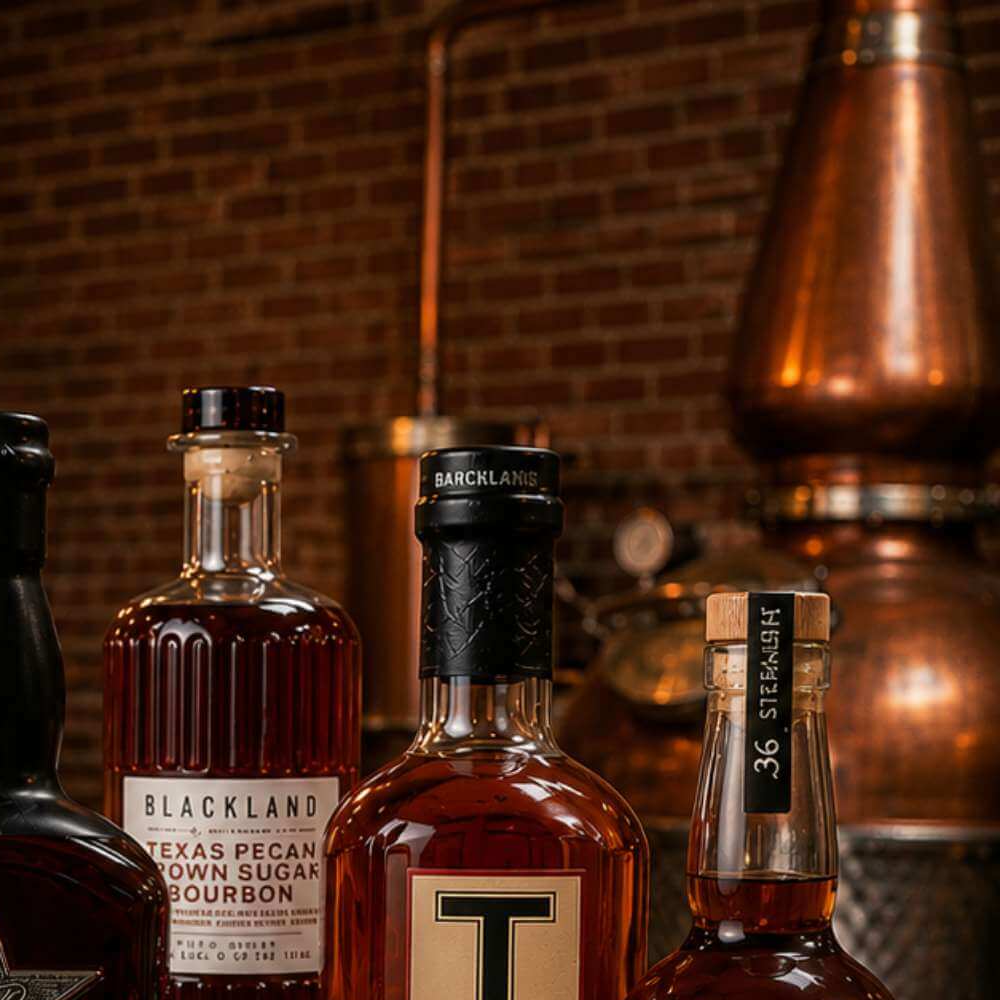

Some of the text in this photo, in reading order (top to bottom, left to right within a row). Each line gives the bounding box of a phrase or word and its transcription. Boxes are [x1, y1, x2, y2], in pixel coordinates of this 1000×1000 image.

[145, 794, 317, 818] BLACKLAND
[147, 840, 316, 860] TEXAS PECAN
[169, 885, 293, 903] BOURBON
